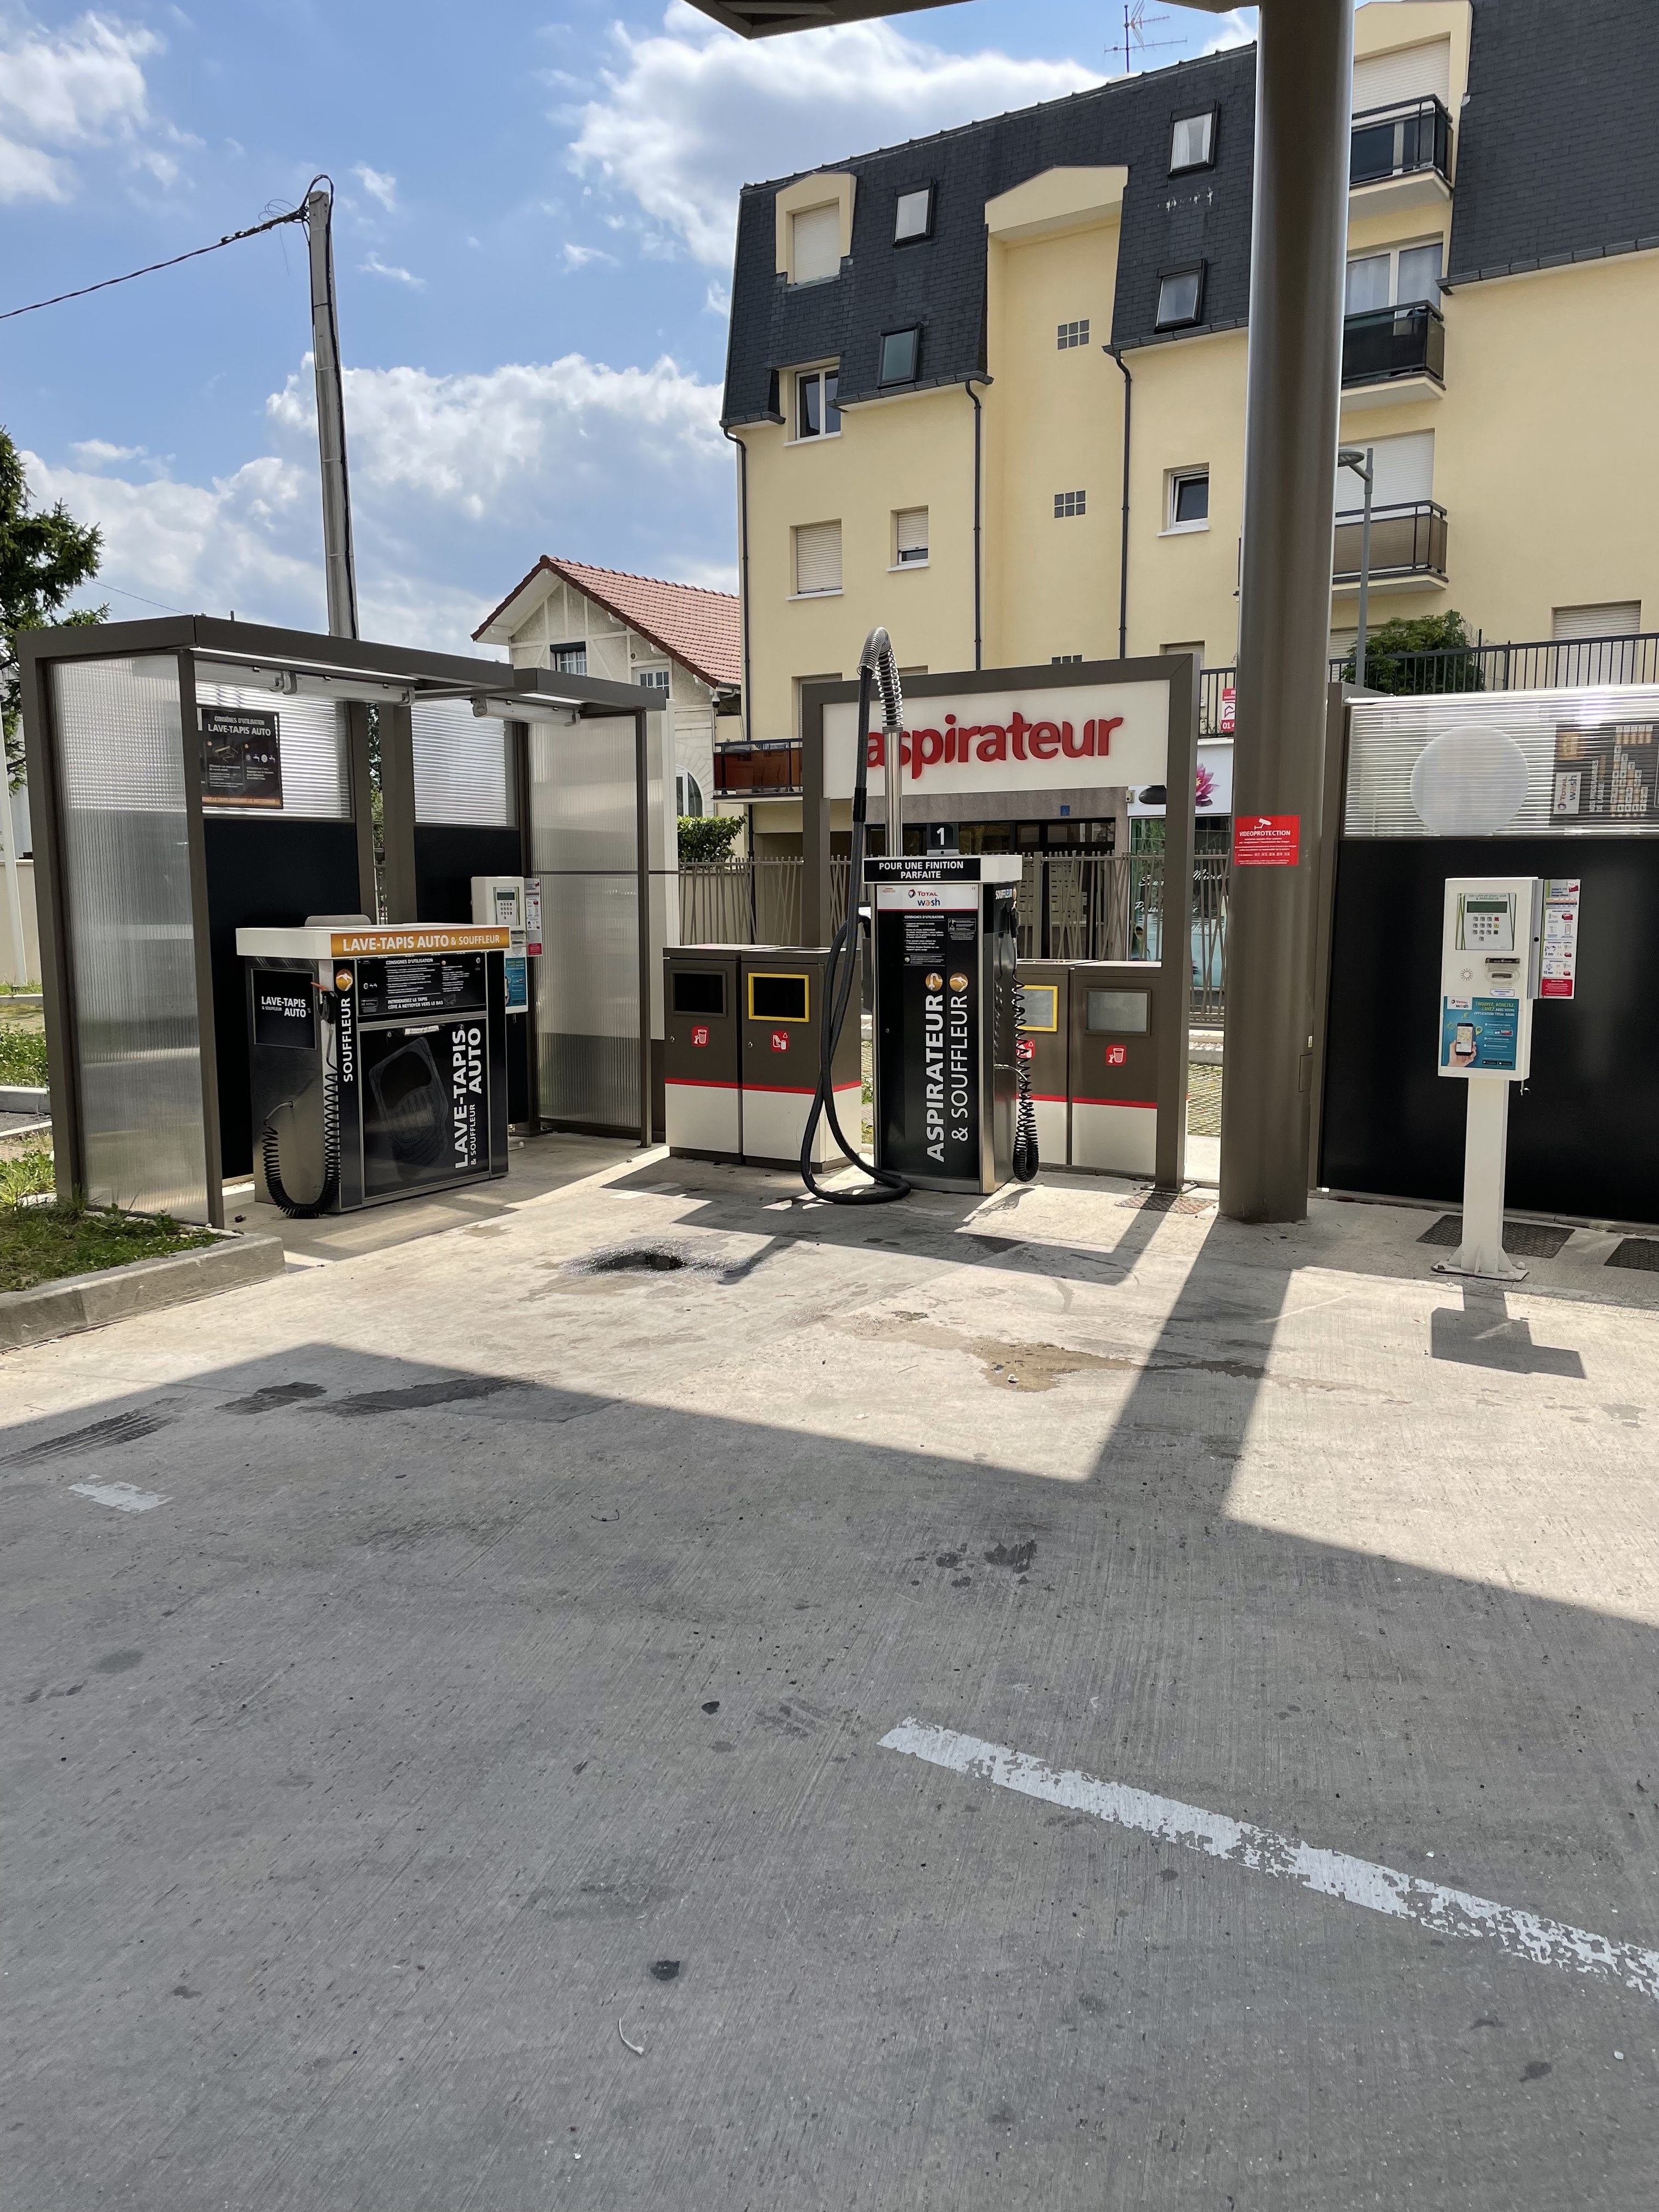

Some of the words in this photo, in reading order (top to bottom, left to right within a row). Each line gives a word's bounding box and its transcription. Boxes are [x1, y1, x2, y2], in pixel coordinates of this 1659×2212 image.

[208, 724, 250, 734] LAVE-TAPIS
[251, 727, 271, 736] AUTO
[1568, 775, 1577, 801] wash
[936, 827, 945, 845] 1
[879, 862, 902, 870] POUR
[905, 861, 923, 870] UNE
[926, 861, 963, 869] FINITION
[901, 871, 941, 879] PARFAITE
[917, 898, 940, 906] wash
[343, 936, 414, 952] LAVE-TAPIS
[417, 934, 449, 949] AUTO
[451, 937, 456, 946] &
[459, 935, 500, 945] SOUFFLEUR
[261, 996, 306, 1008] LAVE-TAPIS
[284, 1008, 306, 1018] AUTO
[341, 997, 353, 1082] SOUFFLEUR
[468, 1028, 482, 1094] AUTO
[951, 995, 968, 1119] SOUFFLEUR
[925, 995, 944, 1163] ASPIRATEUR
[452, 1030, 468, 1168] LAVE-TAPIS
[951, 1127, 968, 1142] &
